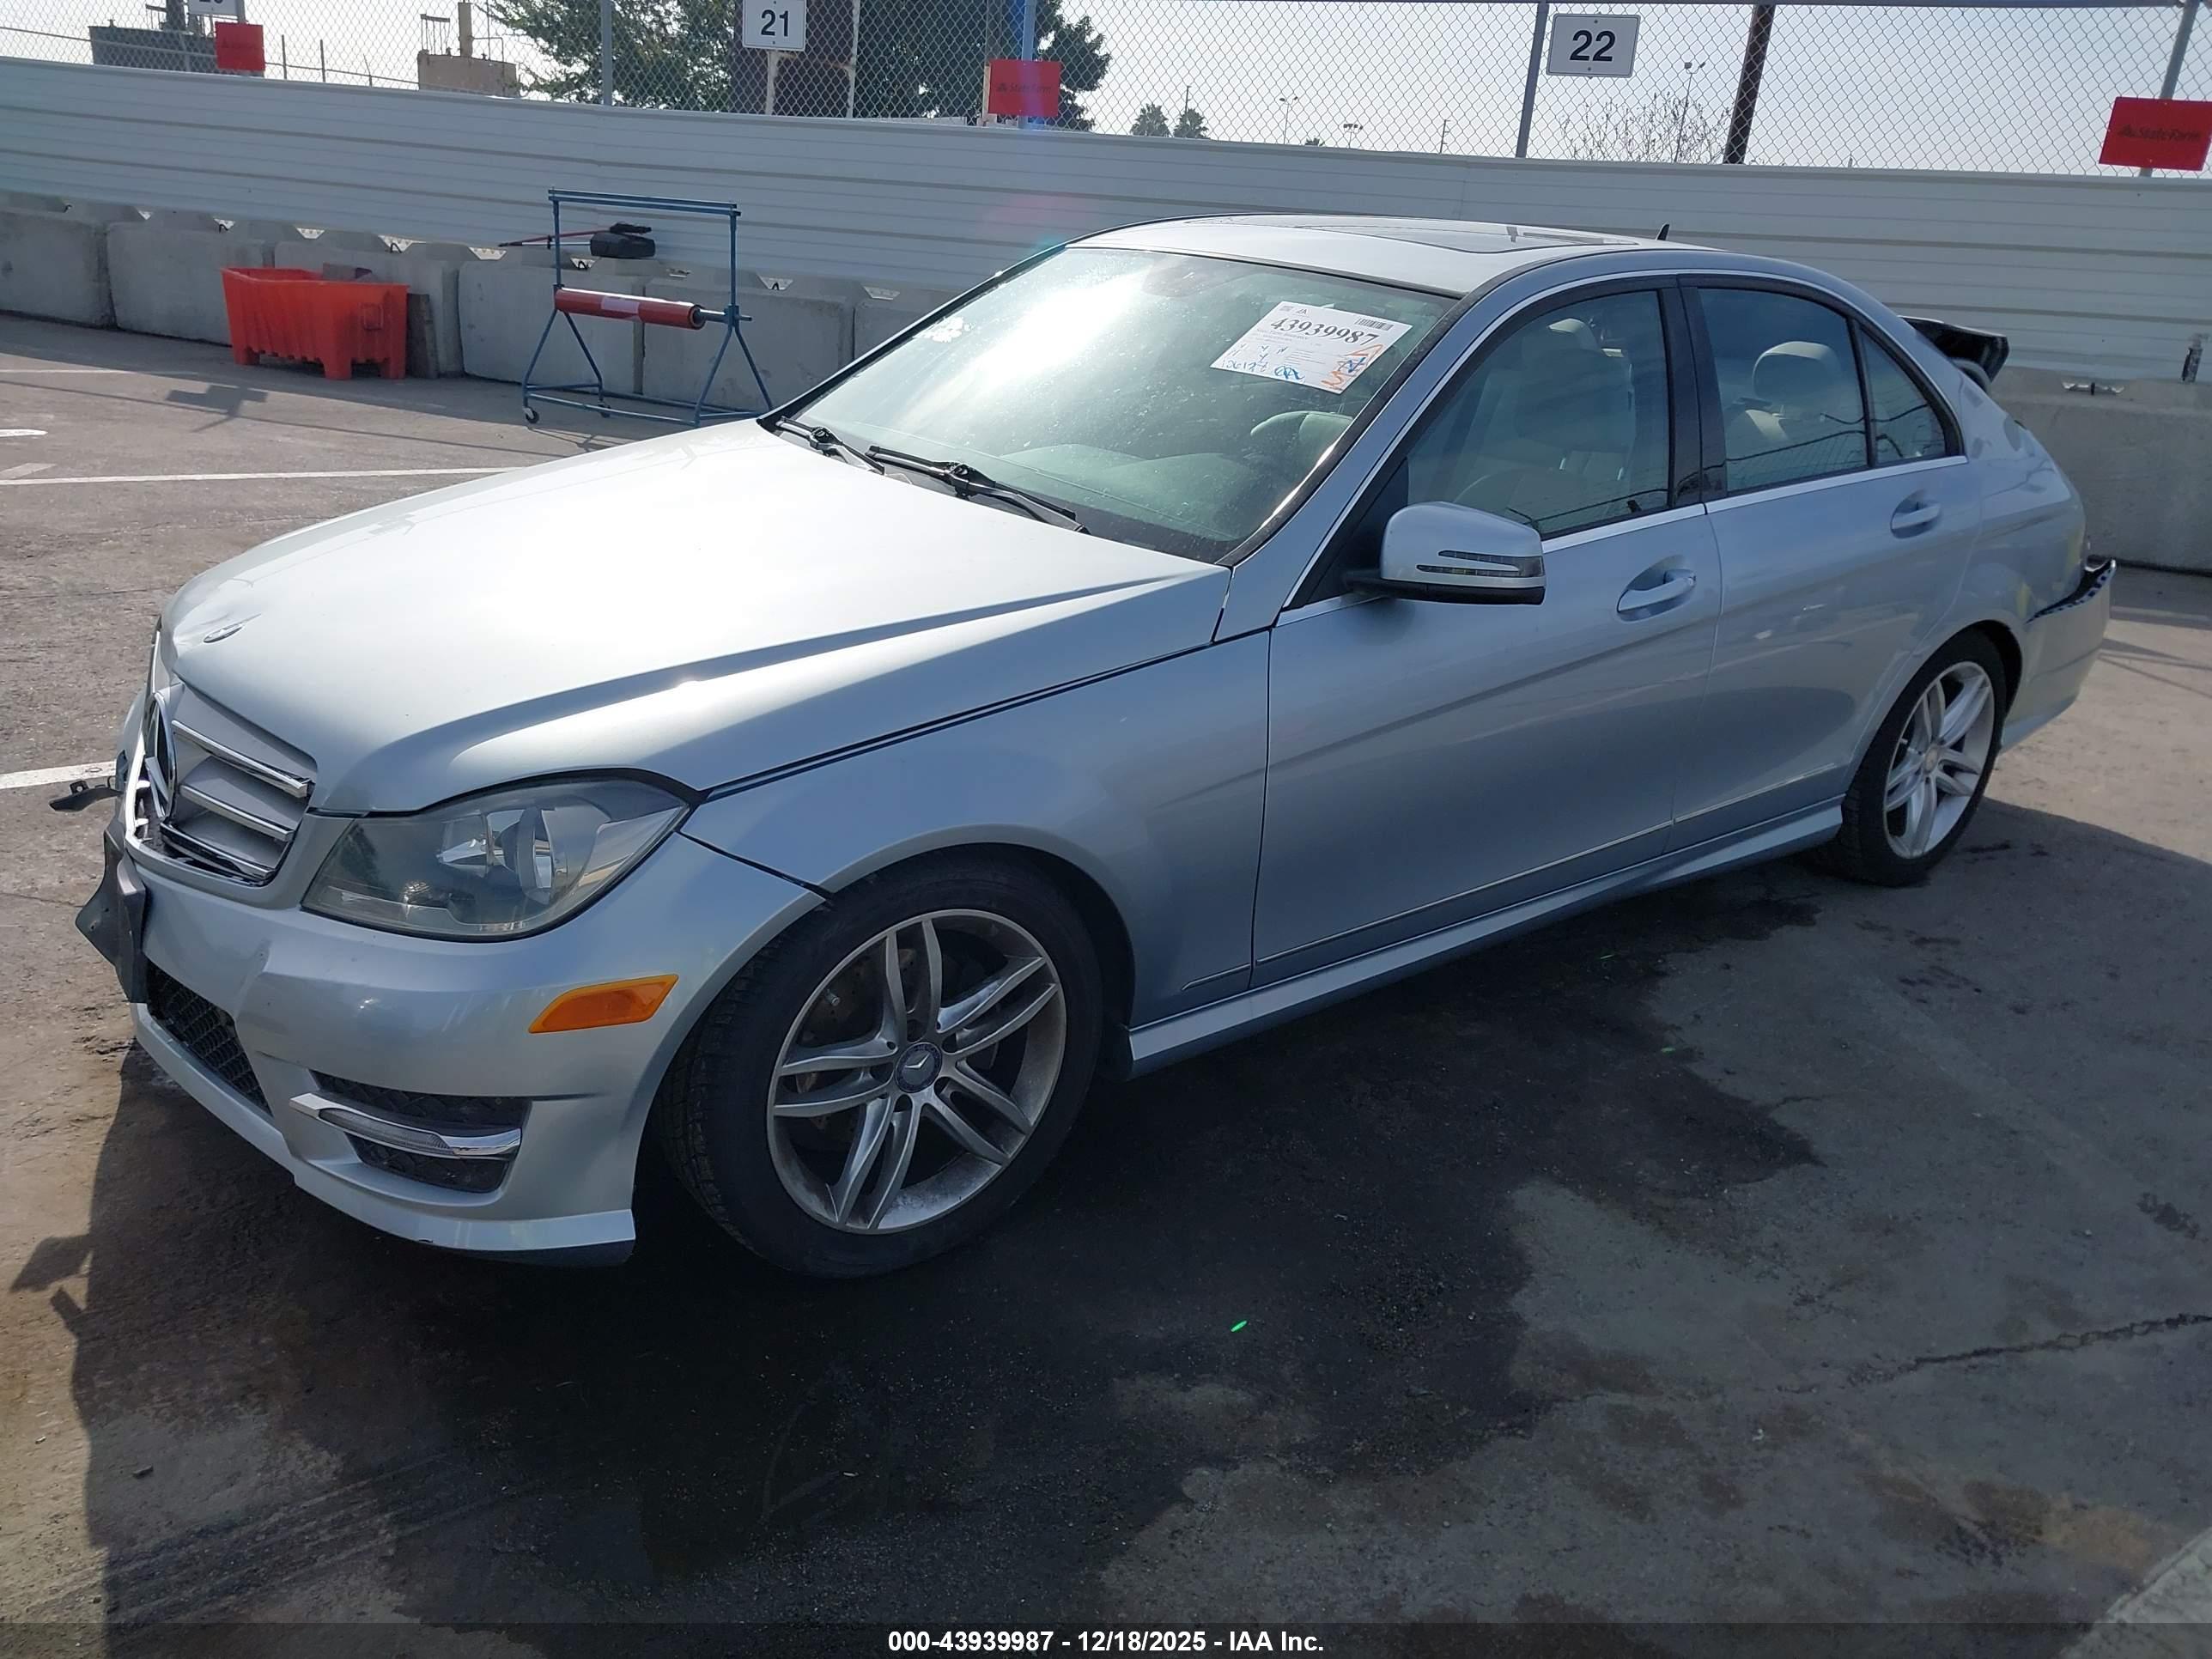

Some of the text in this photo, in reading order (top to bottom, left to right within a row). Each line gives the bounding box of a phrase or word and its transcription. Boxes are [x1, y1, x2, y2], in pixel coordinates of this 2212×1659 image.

[761, 9, 788, 37] 21
[1570, 30, 1615, 61] 22
[1270, 318, 1380, 346] 43939987
